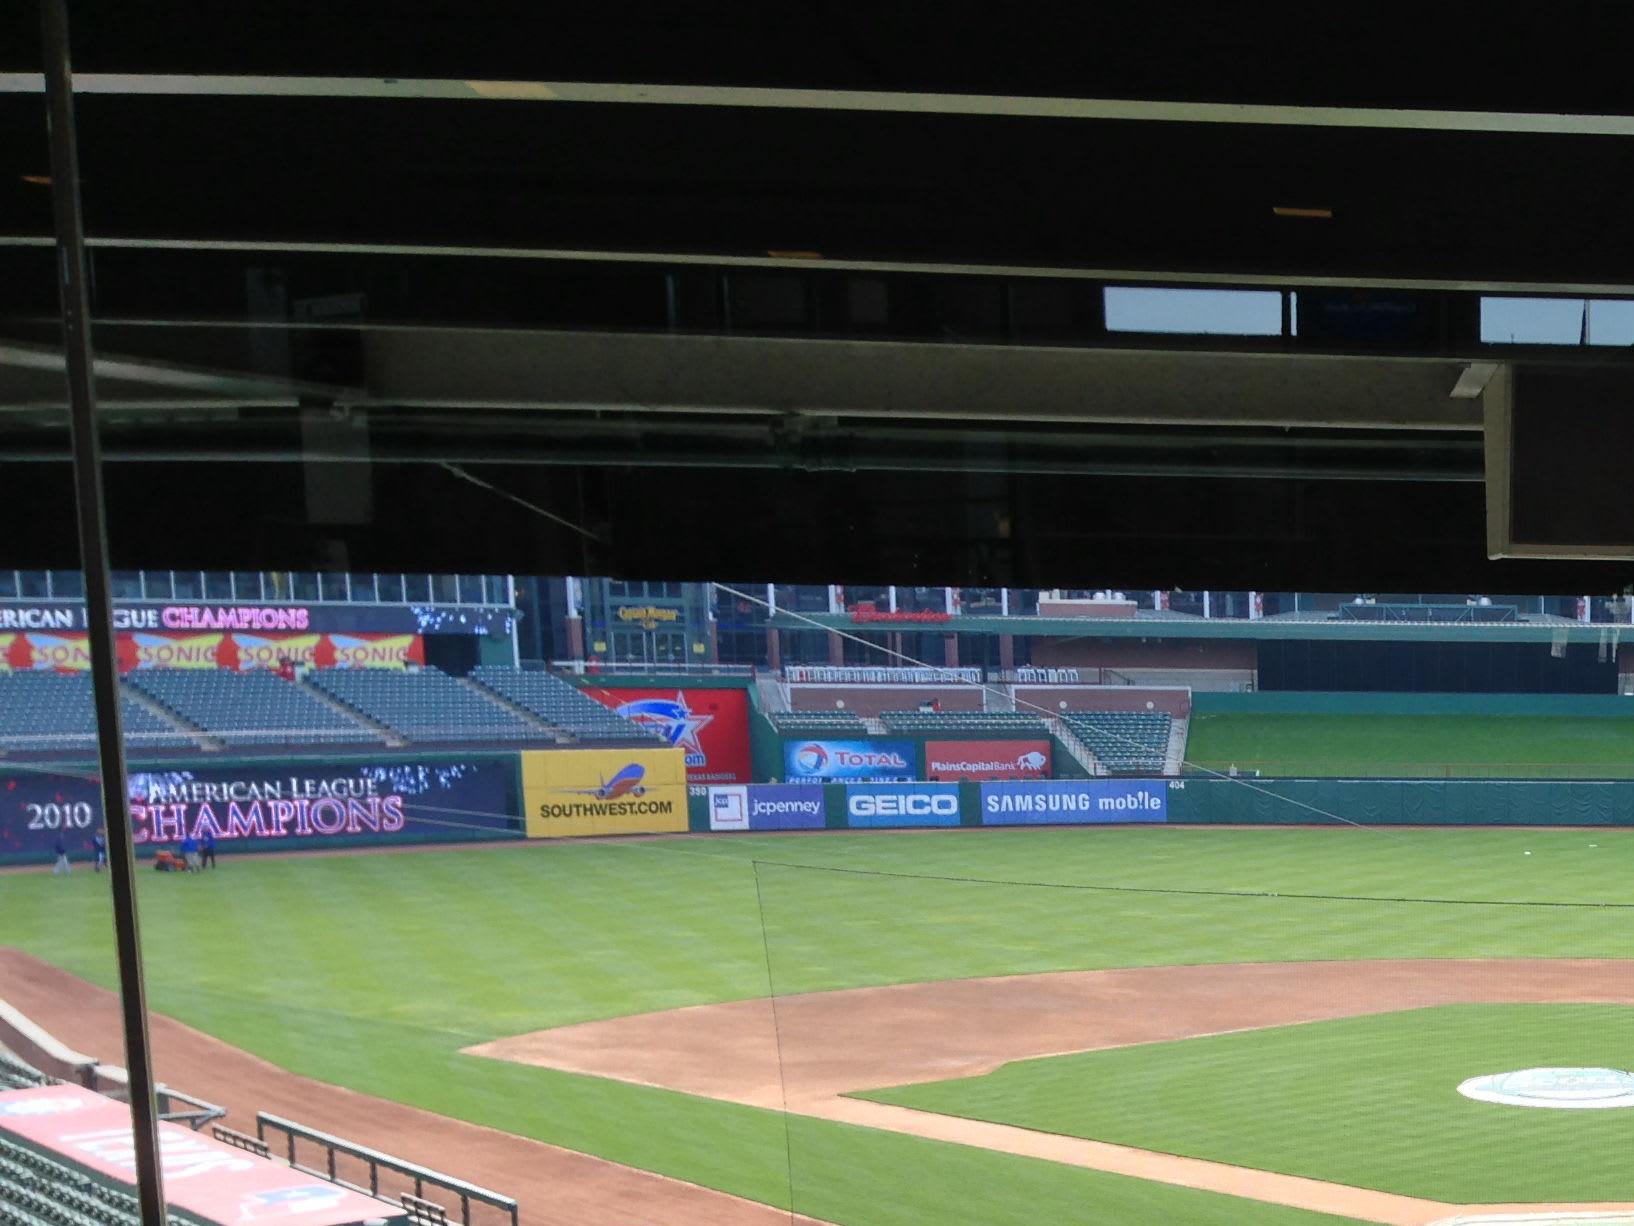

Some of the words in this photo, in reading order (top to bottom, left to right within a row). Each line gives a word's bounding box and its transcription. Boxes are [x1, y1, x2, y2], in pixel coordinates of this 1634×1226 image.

[162, 607, 309, 629] CHAMPIONS
[833, 751, 907, 768] TOTAL
[149, 779, 281, 803] AMERICAN
[290, 775, 378, 799] LEAGUE
[1168, 780, 1185, 790] 404
[540, 801, 673, 818] SOUTHWEST.COM
[752, 799, 820, 815] jcpenney
[849, 794, 958, 816] GEICO
[987, 794, 1090, 813] SAMSUNG
[26, 801, 93, 830] 2010
[129, 795, 404, 843] CHAMPIONS
